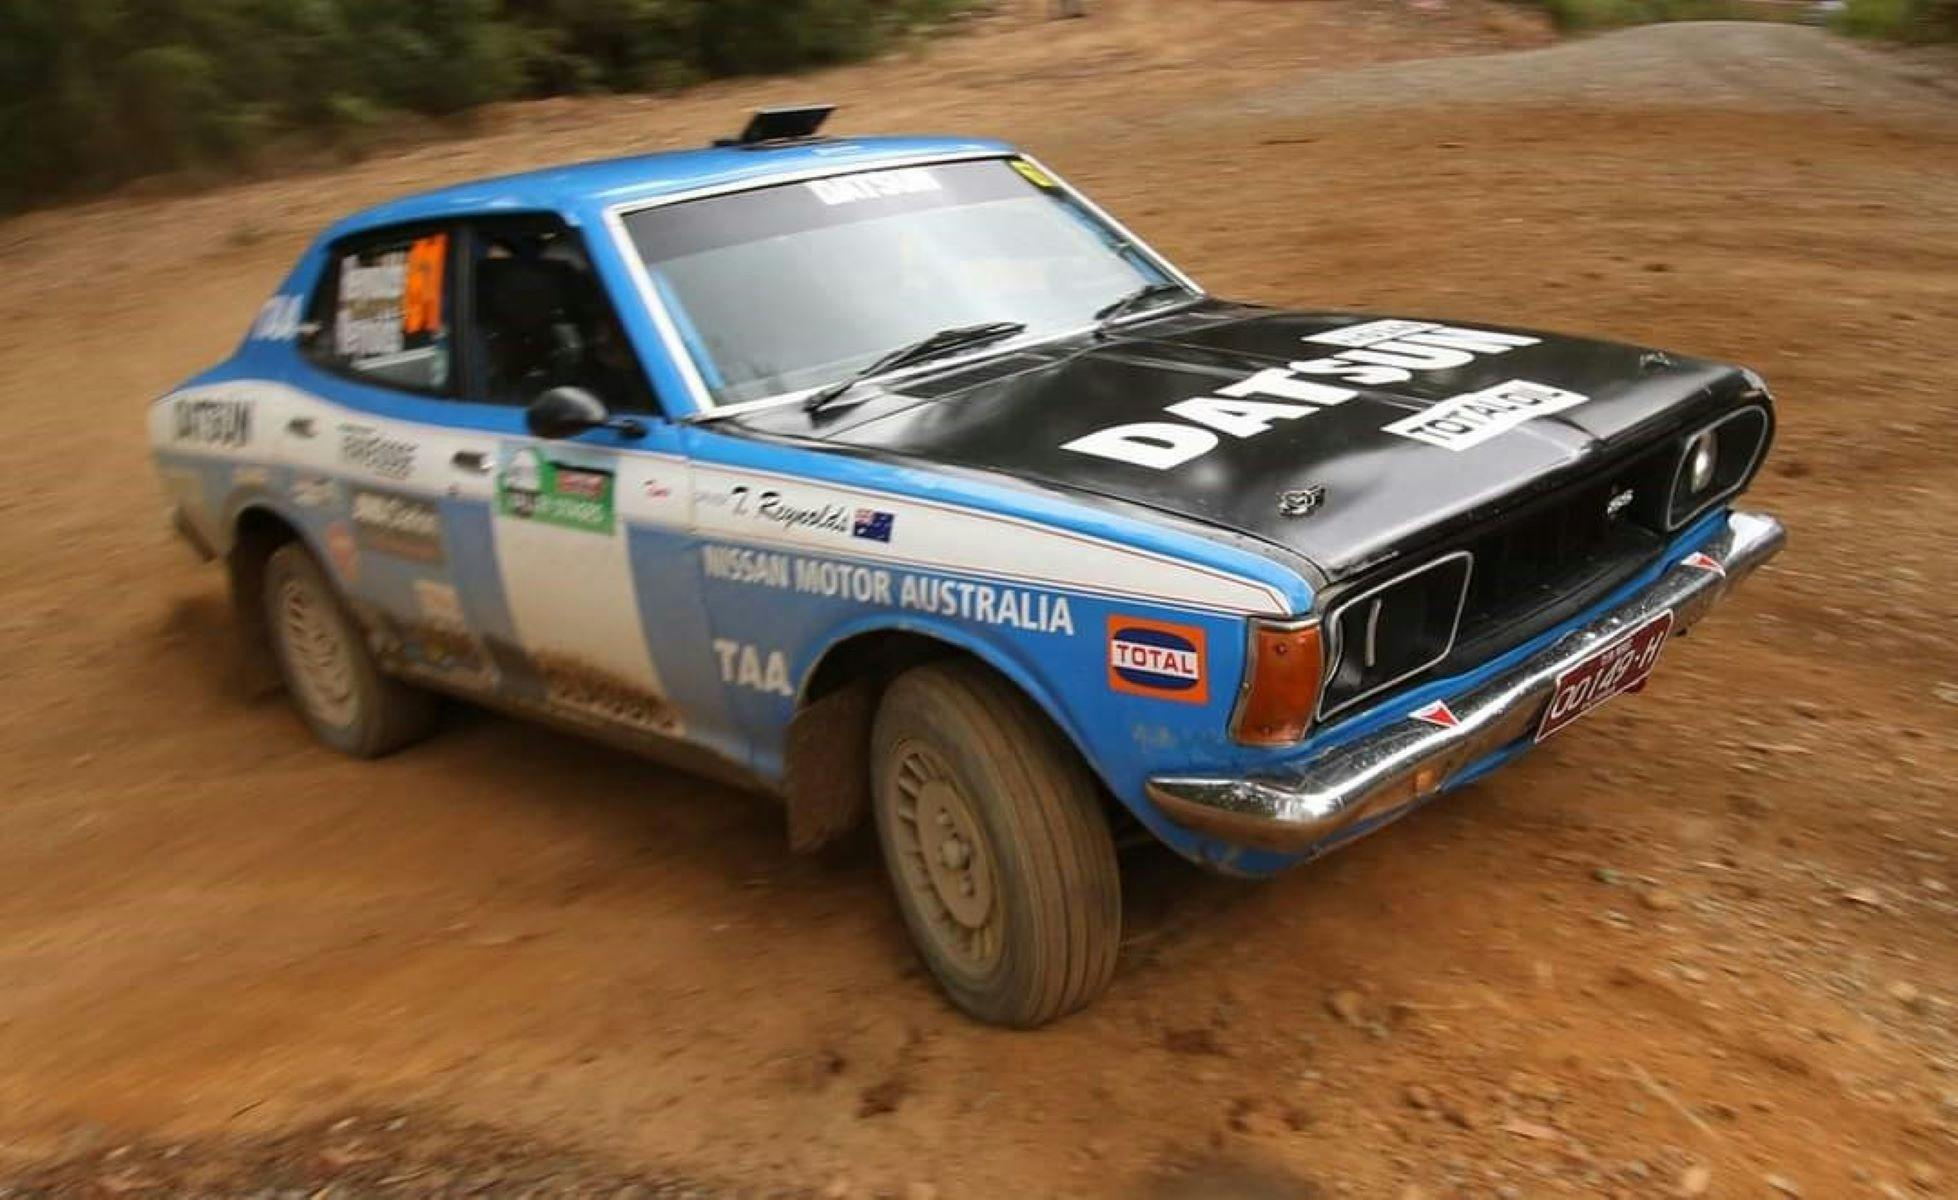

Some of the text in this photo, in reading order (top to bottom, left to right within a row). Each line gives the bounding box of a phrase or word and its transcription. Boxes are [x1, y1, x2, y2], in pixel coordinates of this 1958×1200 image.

[1059, 324, 1542, 471] DATSUN
[1405, 396, 1519, 441] TOTAL
[757, 491, 849, 533] Reynolds
[704, 544, 1075, 636] NISSAN MOTOR AUSTRALIA
[713, 637, 794, 697] TAA
[1115, 643, 1195, 675] TOTAL
